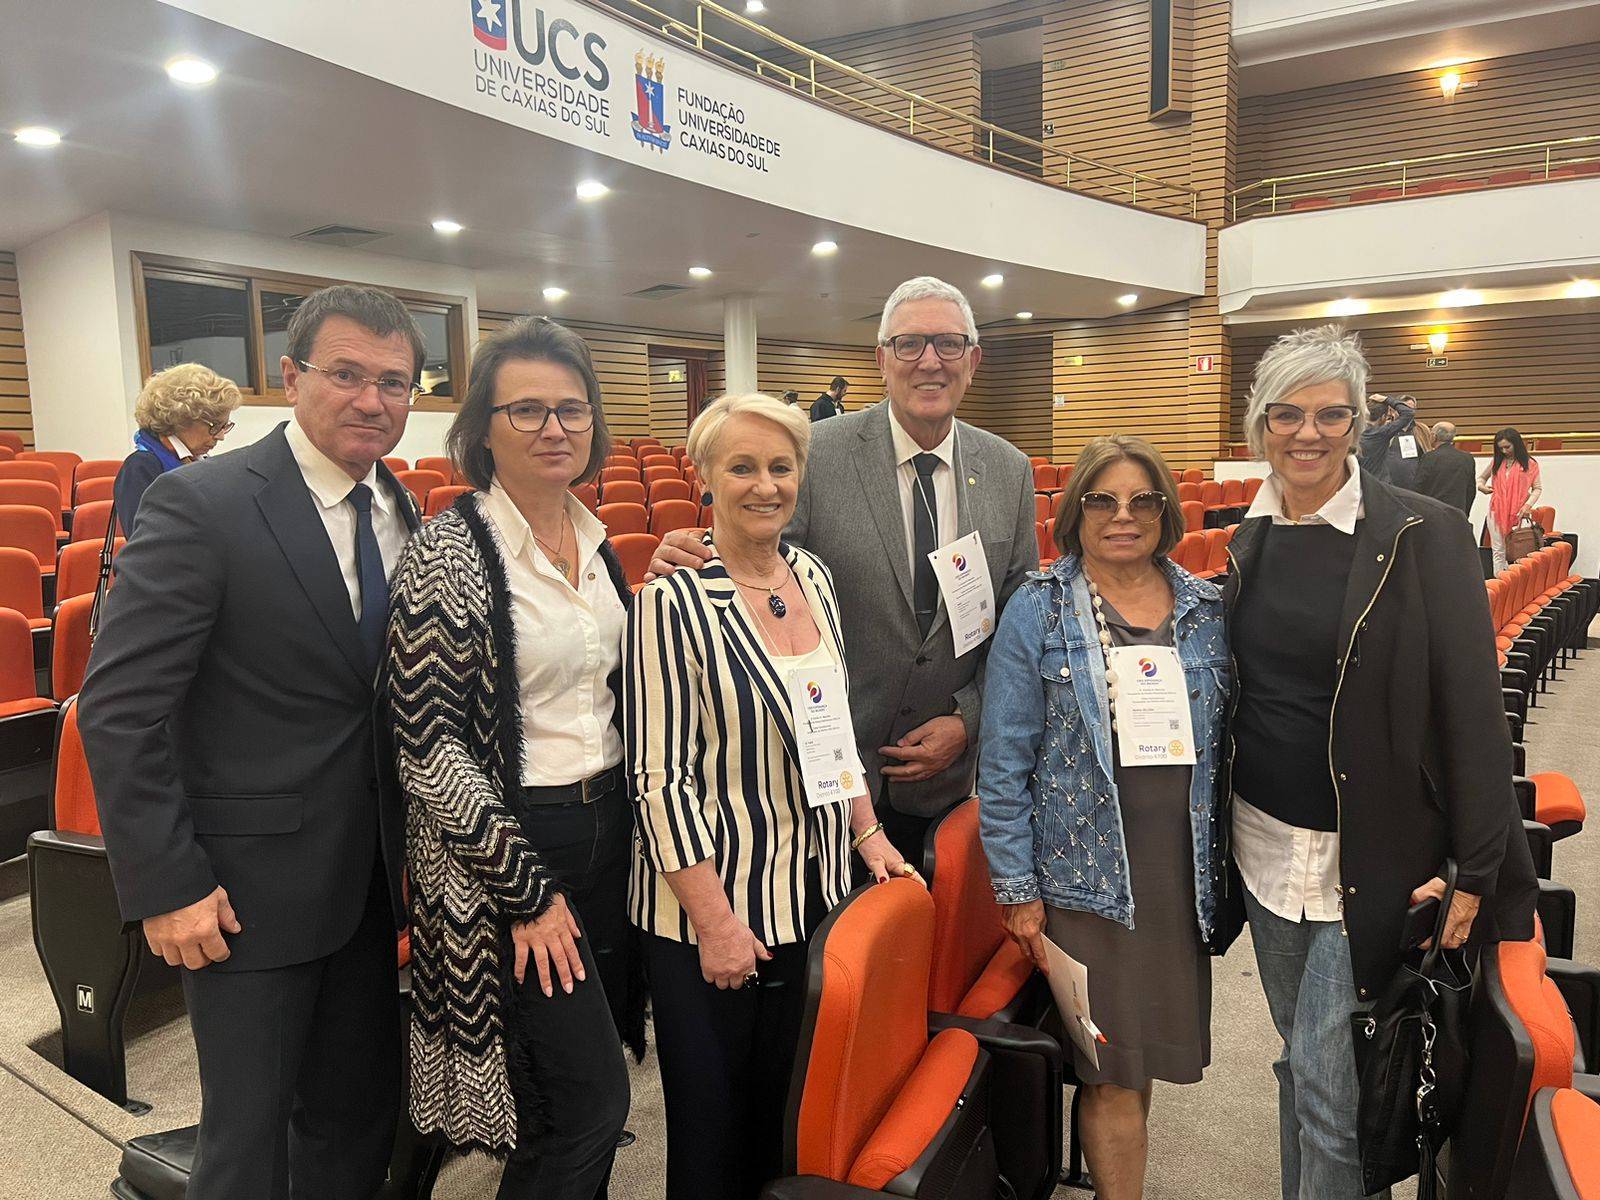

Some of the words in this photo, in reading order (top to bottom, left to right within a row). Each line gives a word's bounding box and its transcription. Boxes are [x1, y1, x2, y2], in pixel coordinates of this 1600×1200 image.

[511, 0, 610, 92] UCS
[473, 48, 610, 119] UNIVERSIDADE
[475, 74, 497, 98] DE
[501, 85, 557, 119] CAXIAS
[561, 106, 581, 127] DO
[585, 114, 611, 137] SUL
[677, 87, 745, 124] FUNDAÇÃO
[678, 108, 765, 152] UNIVERSIDADE
[765, 139, 781, 158] DE
[680, 131, 726, 159] CAXIAS
[727, 145, 745, 165] DO
[746, 152, 769, 173] SUL
[964, 627, 981, 641] Rotary
[1138, 744, 1167, 754] Rotary
[817, 779, 839, 790] Rotary
[79, 989, 92, 1008] M
